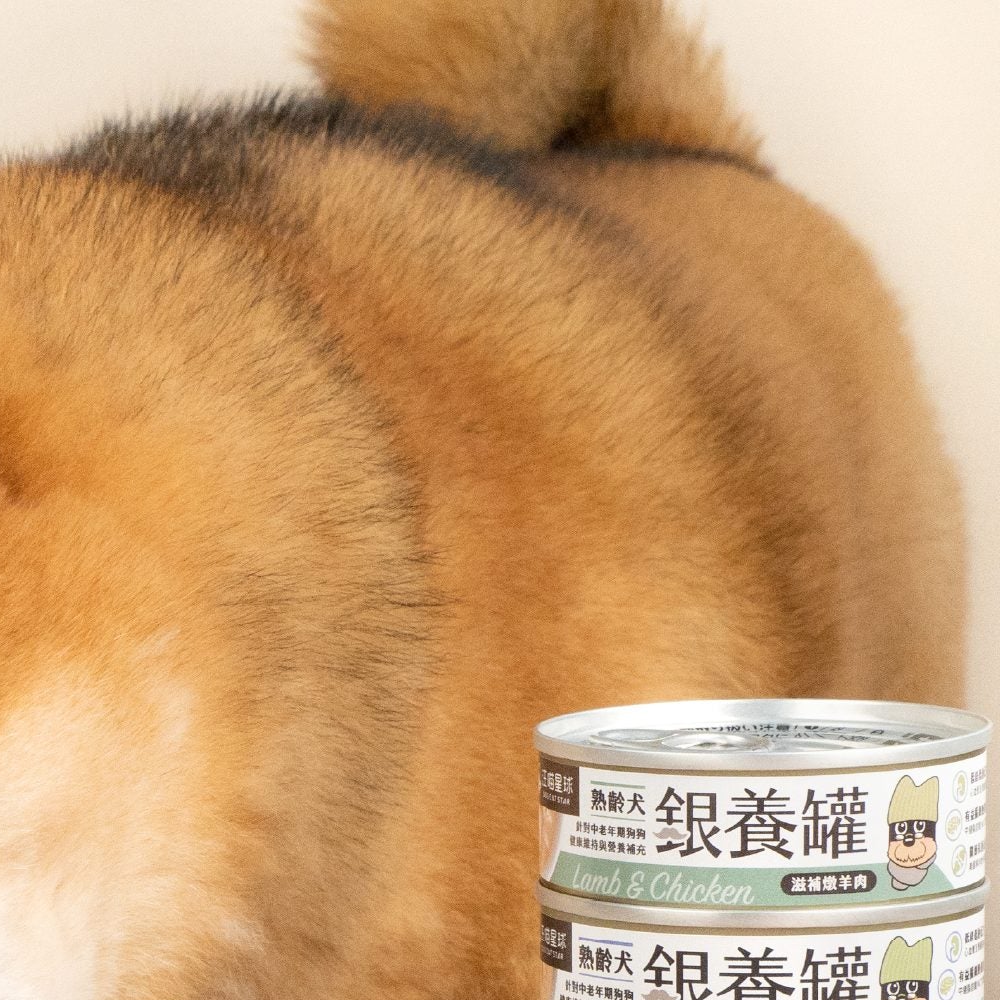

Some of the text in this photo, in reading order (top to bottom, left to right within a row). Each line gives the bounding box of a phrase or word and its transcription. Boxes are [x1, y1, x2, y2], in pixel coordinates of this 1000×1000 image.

[591, 788, 646, 816] 熟齡犬
[575, 821, 646, 840] 針對中老年期狗狗
[654, 786, 869, 860] 銀養罐
[571, 863, 755, 905] Lamb & Chicken
[790, 874, 867, 893] 滋補燉羊肉
[578, 944, 634, 976] 熟齡犬
